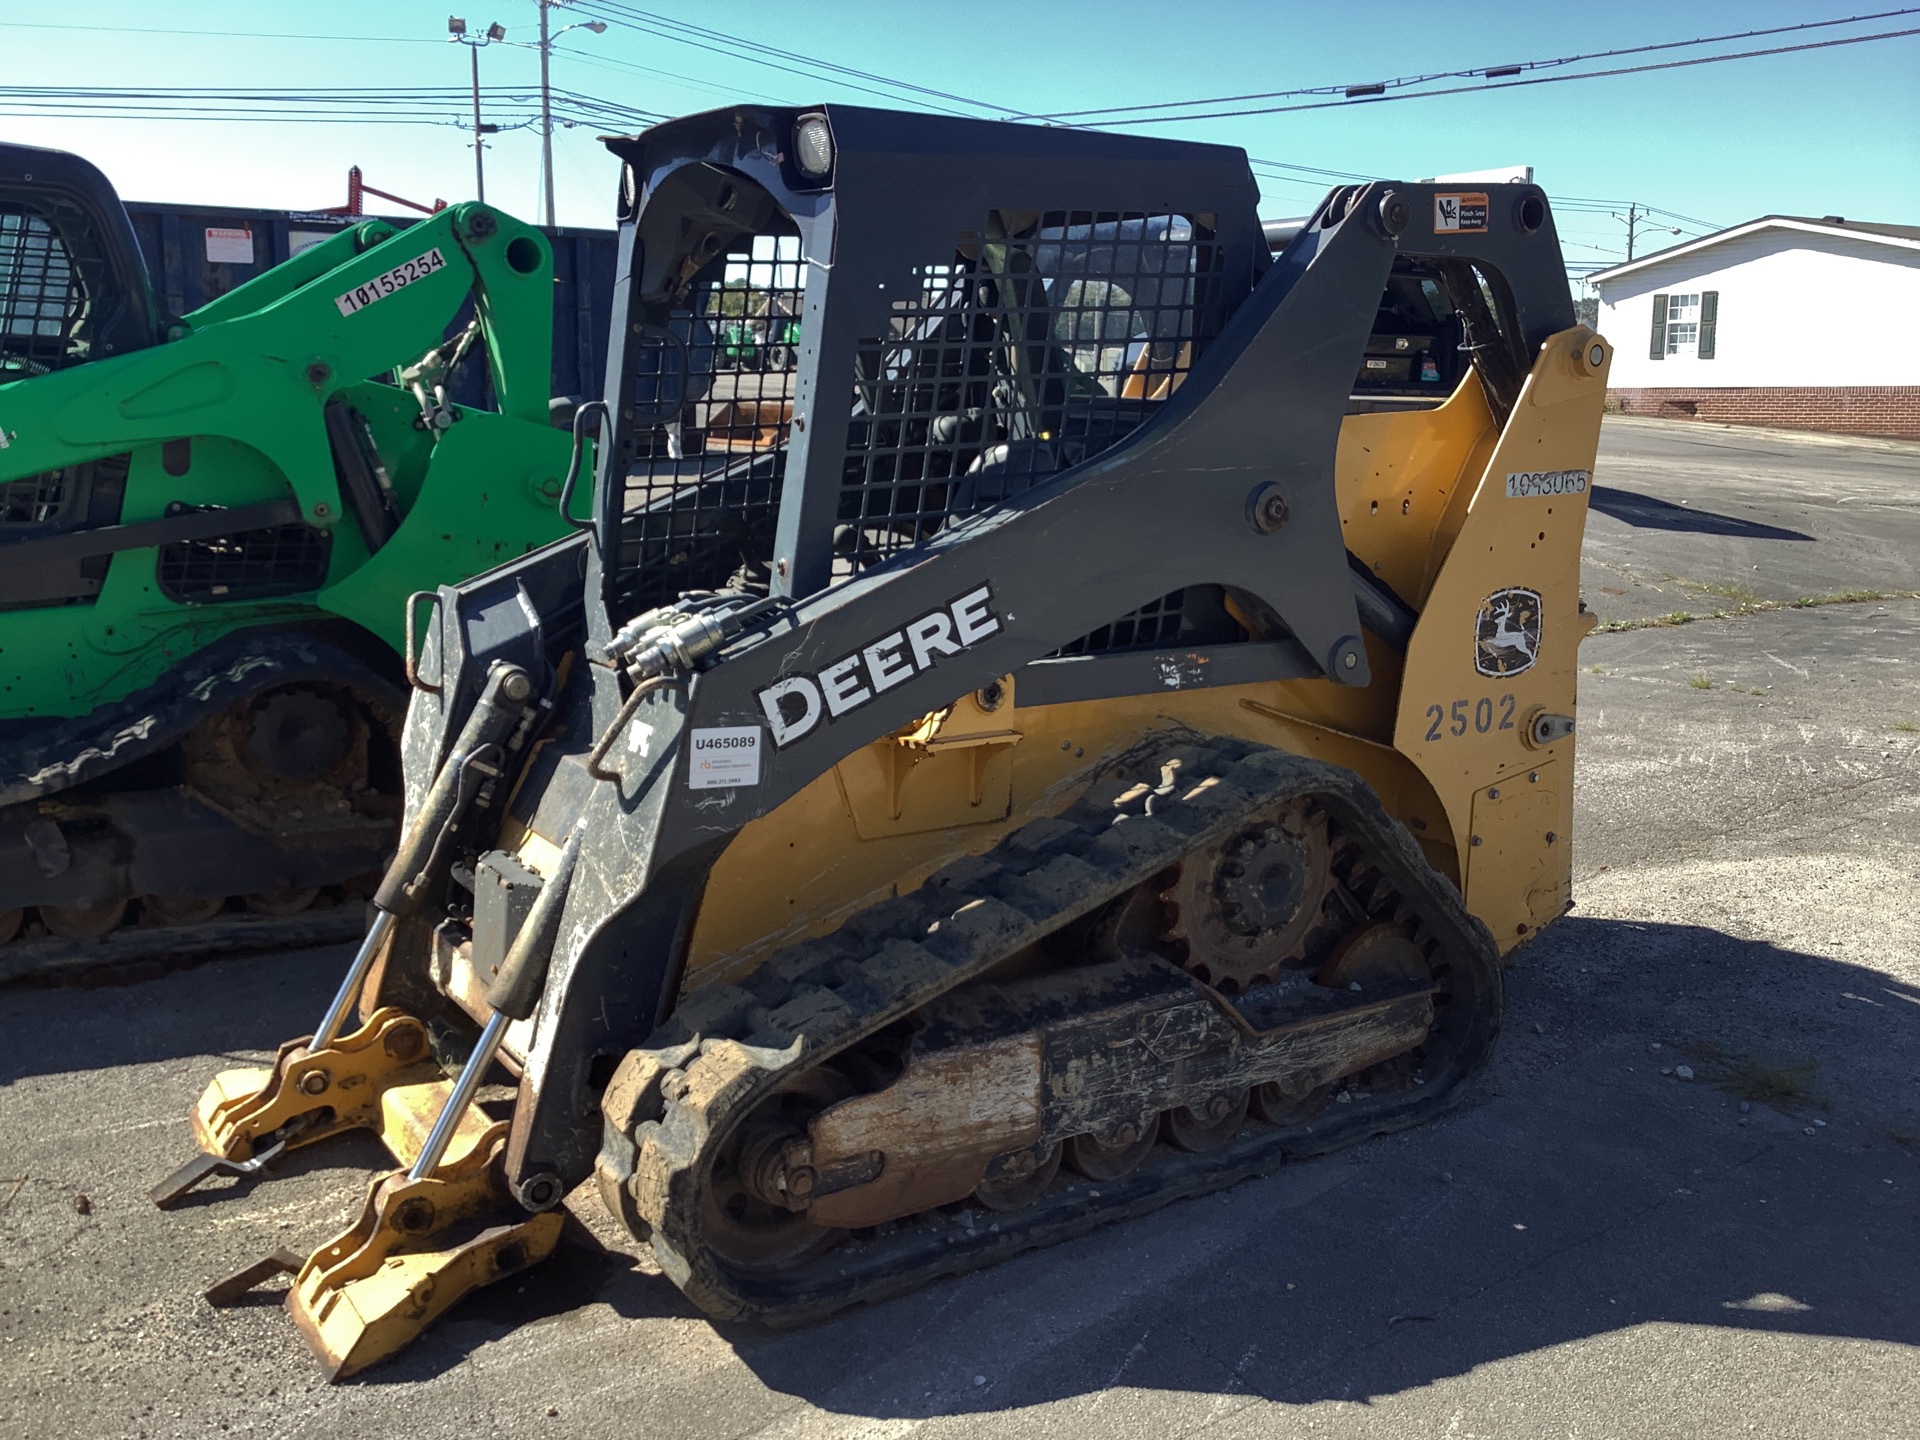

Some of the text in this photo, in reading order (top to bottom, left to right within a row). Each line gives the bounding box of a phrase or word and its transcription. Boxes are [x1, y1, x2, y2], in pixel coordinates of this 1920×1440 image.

[212, 230, 247, 239] WARNING
[344, 250, 444, 311] 10155254
[759, 586, 998, 747] DEERE
[1425, 693, 1517, 742] 2502
[696, 736, 755, 750] U465089
